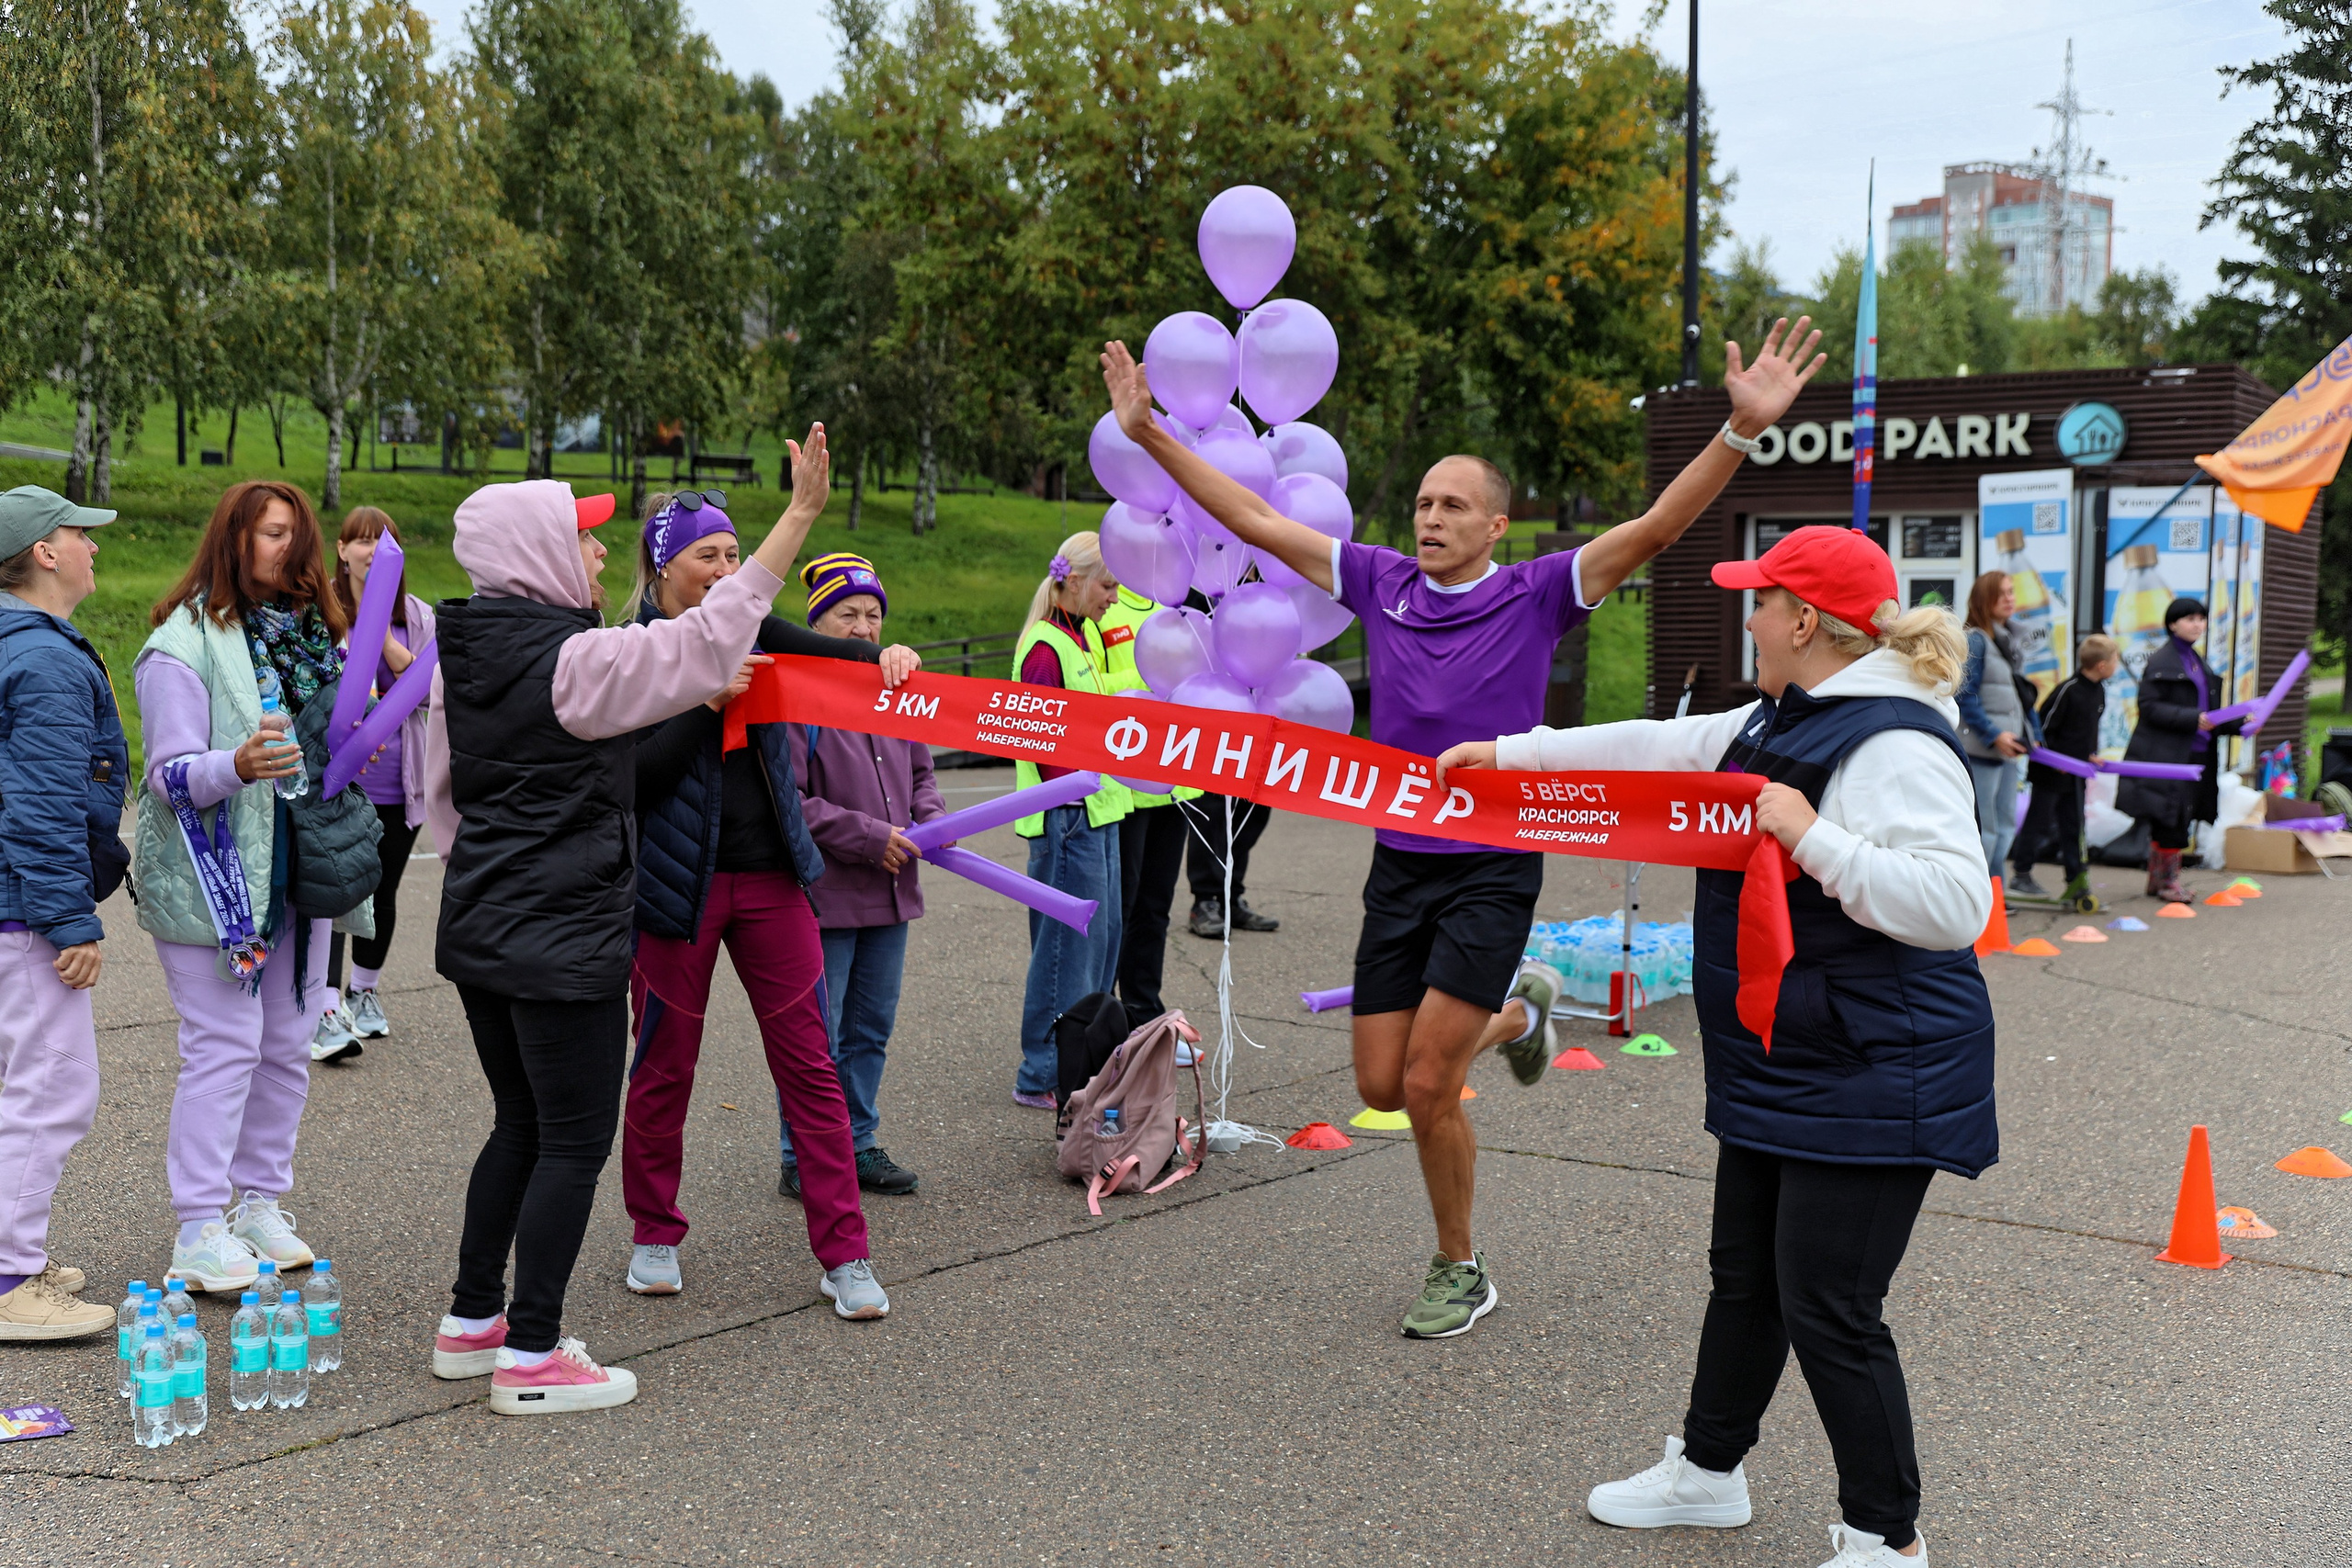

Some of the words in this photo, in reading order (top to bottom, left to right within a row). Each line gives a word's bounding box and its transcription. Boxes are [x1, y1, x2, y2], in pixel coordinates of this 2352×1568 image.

[1748, 421, 1854, 466] OOD
[1883, 412, 2033, 460] PARK
[873, 689, 894, 712] 5
[895, 692, 941, 719] КМ
[989, 692, 1003, 708] 5
[1004, 692, 1069, 717] ВЁРСТ
[977, 713, 1068, 737] КРАСНОЯРСК
[976, 731, 1057, 752] НАБЕРЕЖНАЯ
[1104, 716, 1476, 825] ФИНИШЁР
[1519, 782, 1534, 800] 5
[1536, 778, 1607, 803] ВЁРСТ
[169, 790, 193, 829] ЖИЗНЬ
[1518, 807, 1621, 826] КРАСНОЯРСК
[1668, 800, 1689, 832] 5
[1698, 802, 1753, 836] КМ
[1515, 829, 1610, 845] НАБЕРЕЖНАЯ
[213, 892, 226, 909] ЗАБЕГ
